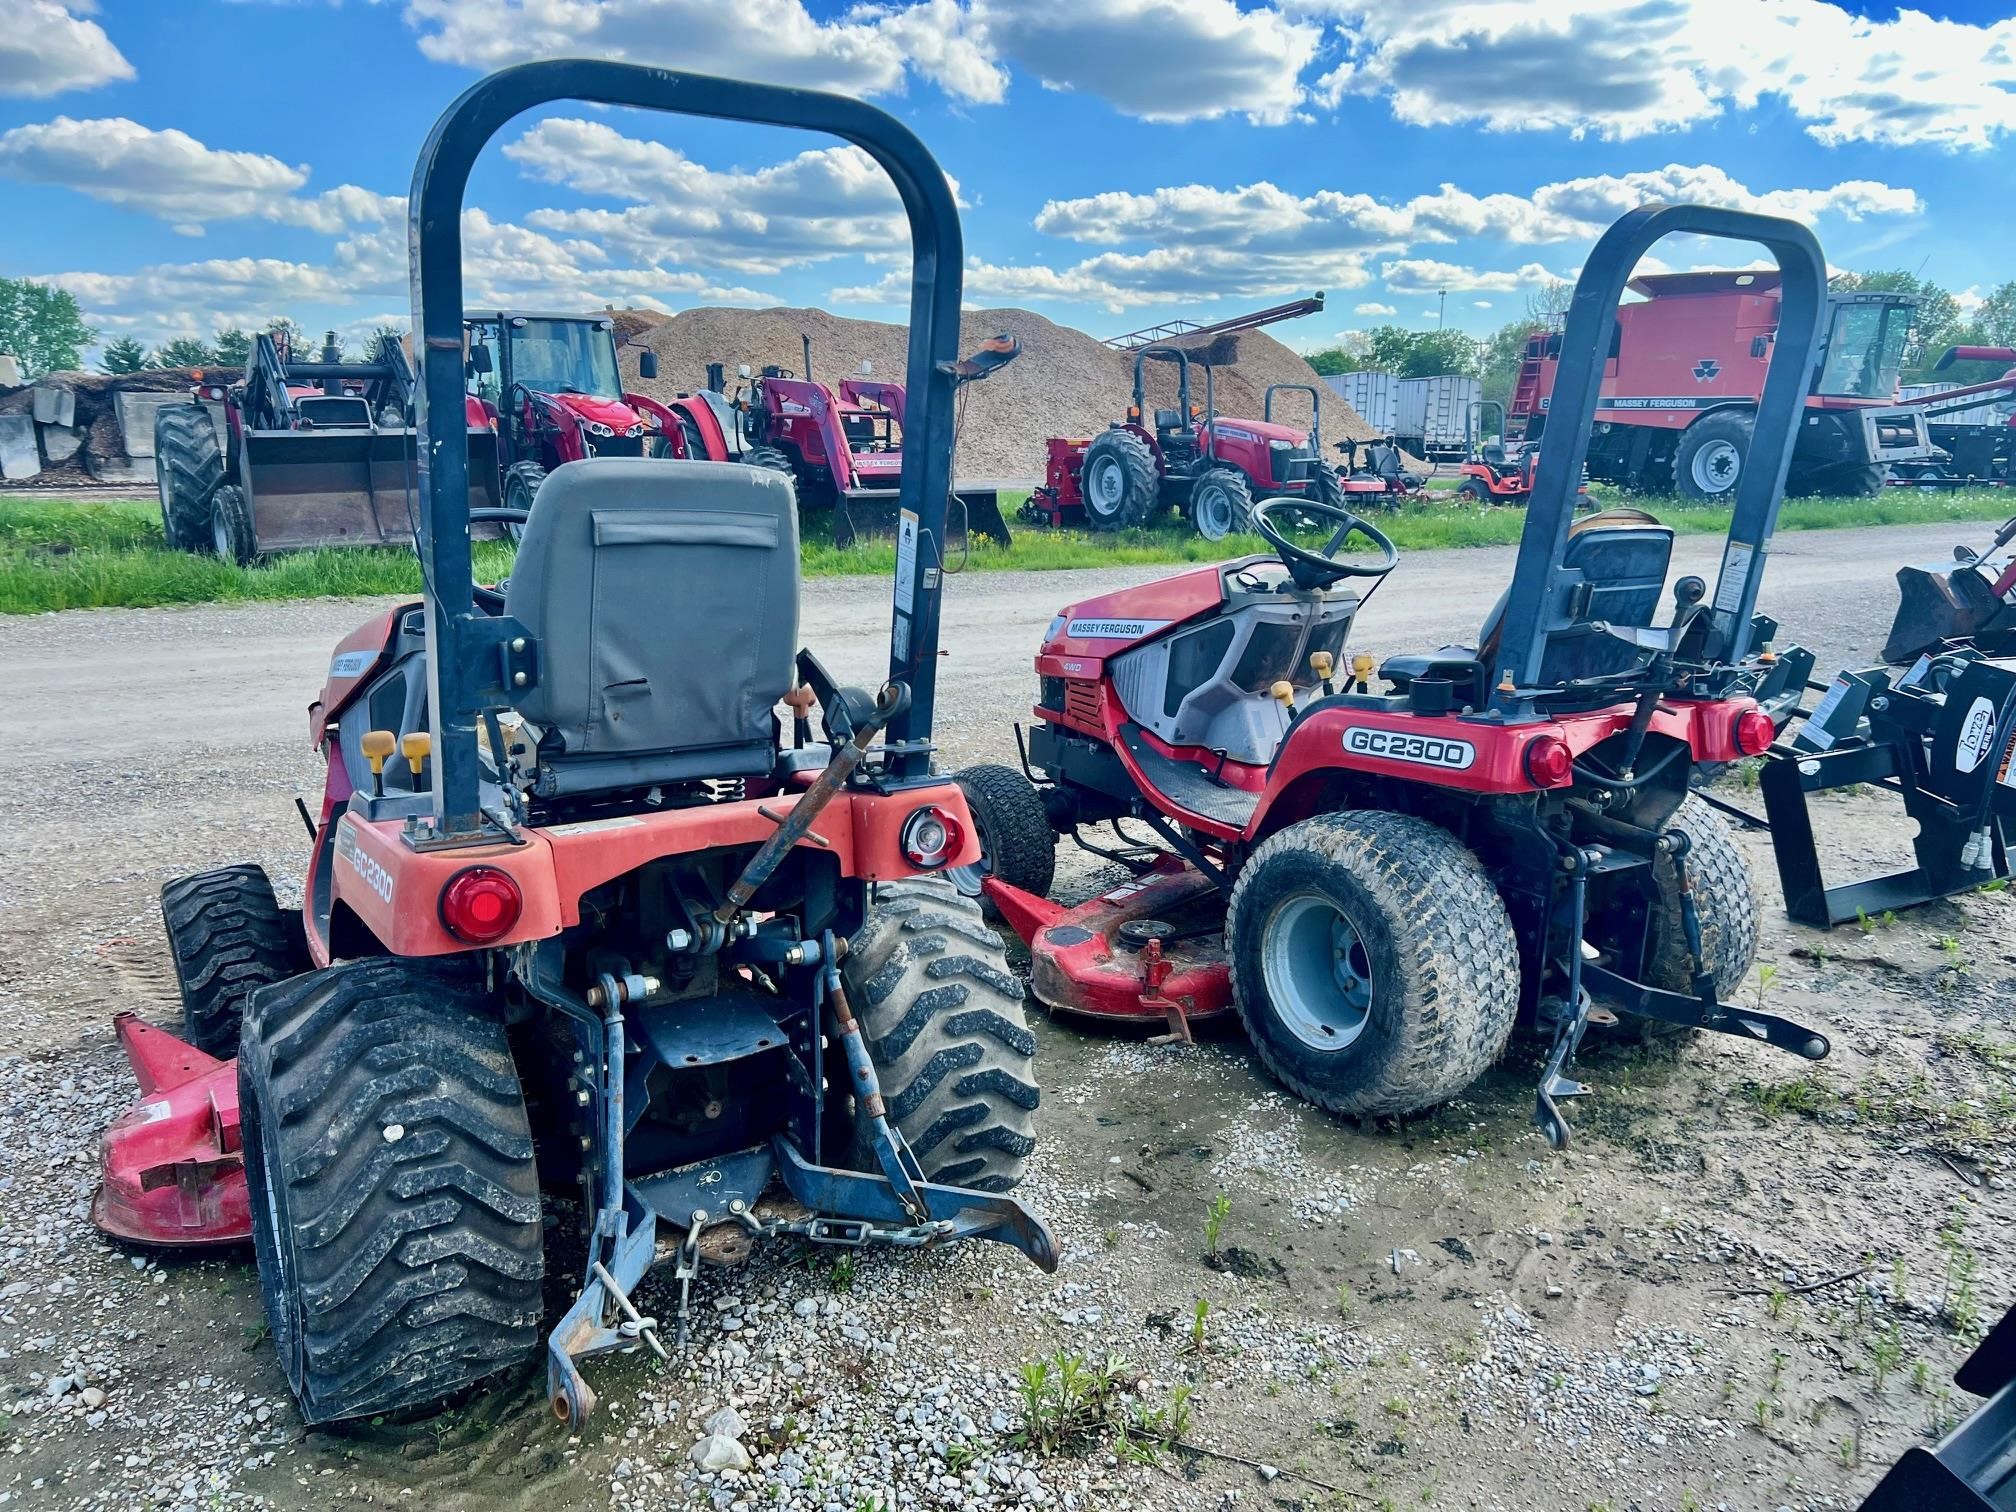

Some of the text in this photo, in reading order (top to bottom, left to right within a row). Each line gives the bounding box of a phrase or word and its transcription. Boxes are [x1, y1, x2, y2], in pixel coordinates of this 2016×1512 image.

[1613, 399, 1696, 408] MASSEY FERGUSON
[1070, 623, 1145, 635] MASSEY FERGUSON
[1063, 662, 1082, 672] 4WD
[1351, 731, 1465, 764] GC2300
[1980, 725, 1995, 751] BERLON
[2001, 724, 2016, 765] WARNI
[353, 847, 394, 904] GC2300
